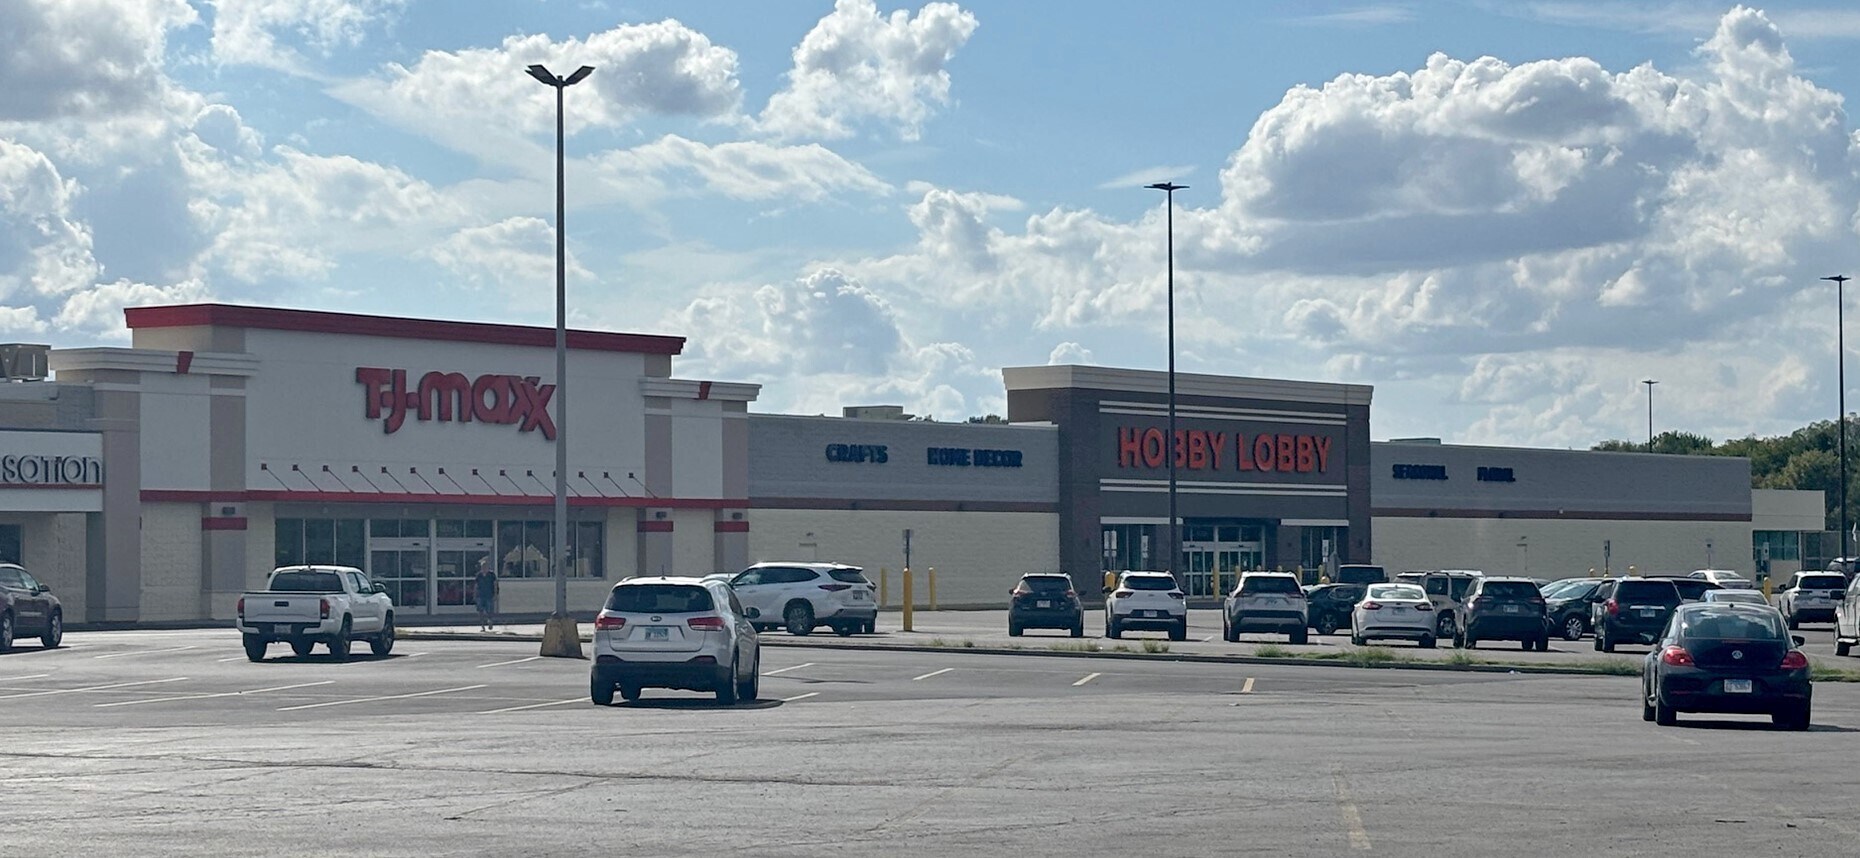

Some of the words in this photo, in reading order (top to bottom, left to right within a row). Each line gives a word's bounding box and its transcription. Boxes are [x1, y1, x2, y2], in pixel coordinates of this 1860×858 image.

[825, 443, 889, 464] CRAFTS
[927, 447, 971, 467] HOME
[1118, 426, 1226, 470] HOBBY
[1237, 433, 1332, 473] LOBBY
[0, 454, 103, 483] sation
